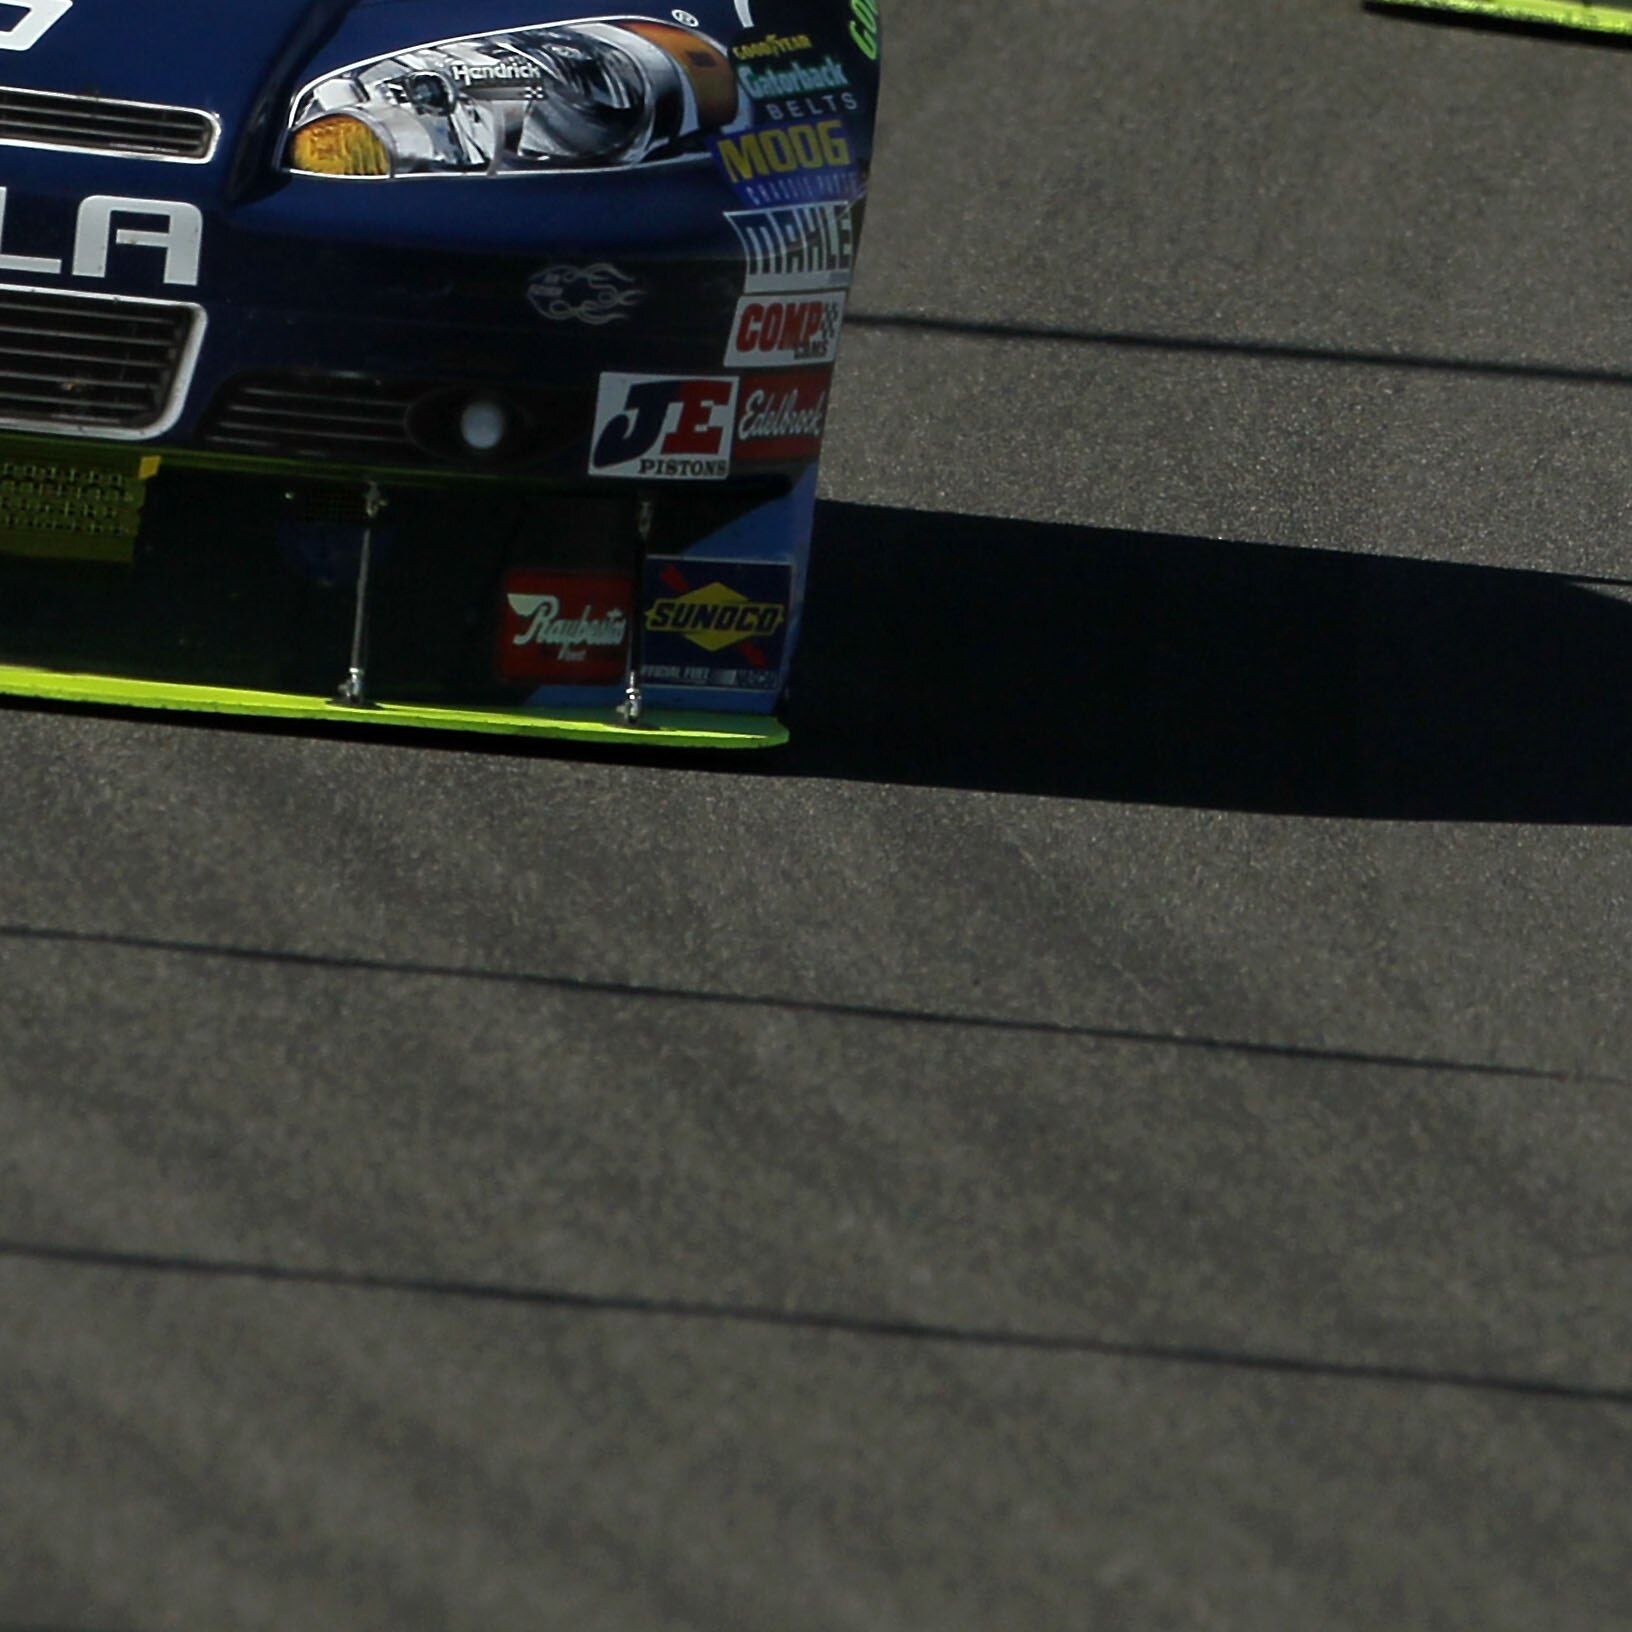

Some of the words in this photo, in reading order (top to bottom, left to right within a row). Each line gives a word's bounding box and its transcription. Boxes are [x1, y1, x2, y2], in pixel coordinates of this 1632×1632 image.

[451, 62, 542, 86] Hendrick
[765, 92, 858, 120] BELTS
[717, 120, 852, 184] MOOG
[735, 301, 823, 354] COMP
[593, 380, 732, 468] JE
[638, 459, 728, 477] PISTONS
[653, 602, 780, 633] SUNOCO
